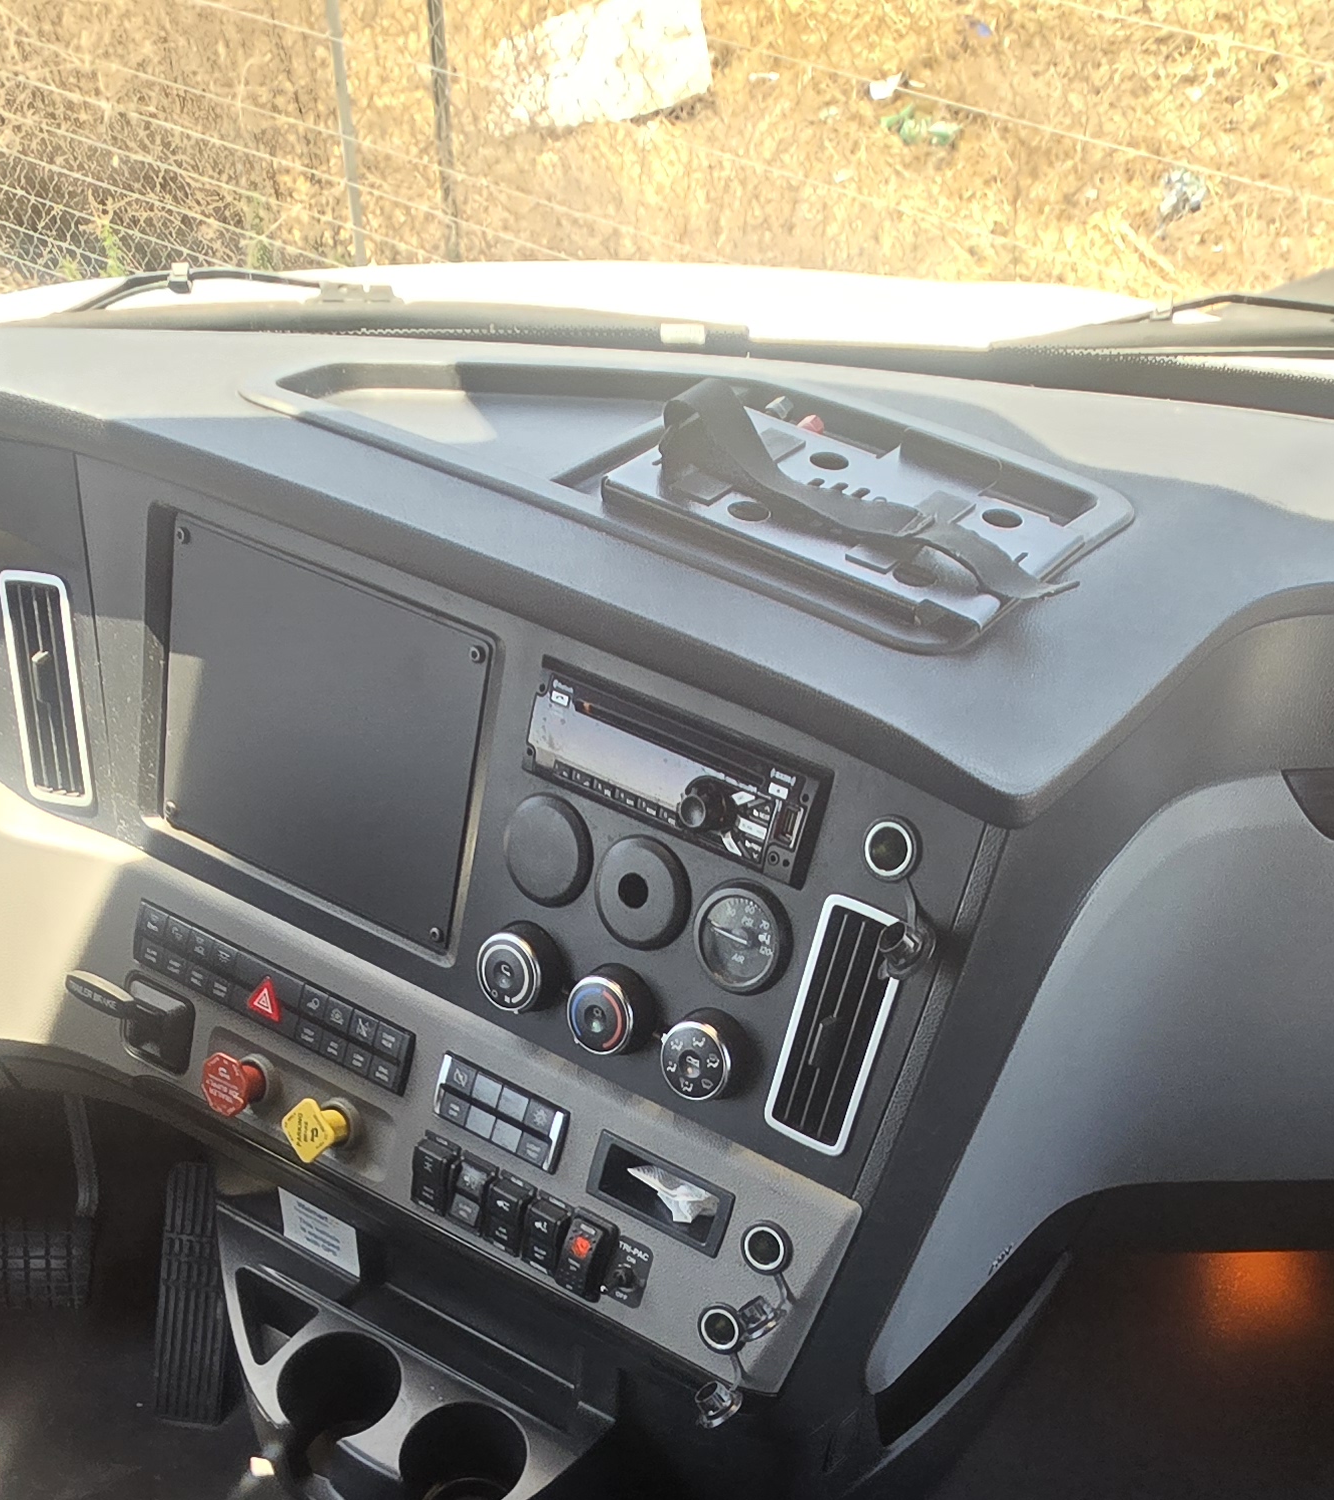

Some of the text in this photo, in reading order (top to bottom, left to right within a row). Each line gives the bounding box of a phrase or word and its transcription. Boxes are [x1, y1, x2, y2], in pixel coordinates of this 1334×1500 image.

[731, 953, 745, 964] AIR
[296, 1112, 304, 1147] PARKING
[619, 1240, 649, 1261] TRI-PAC
